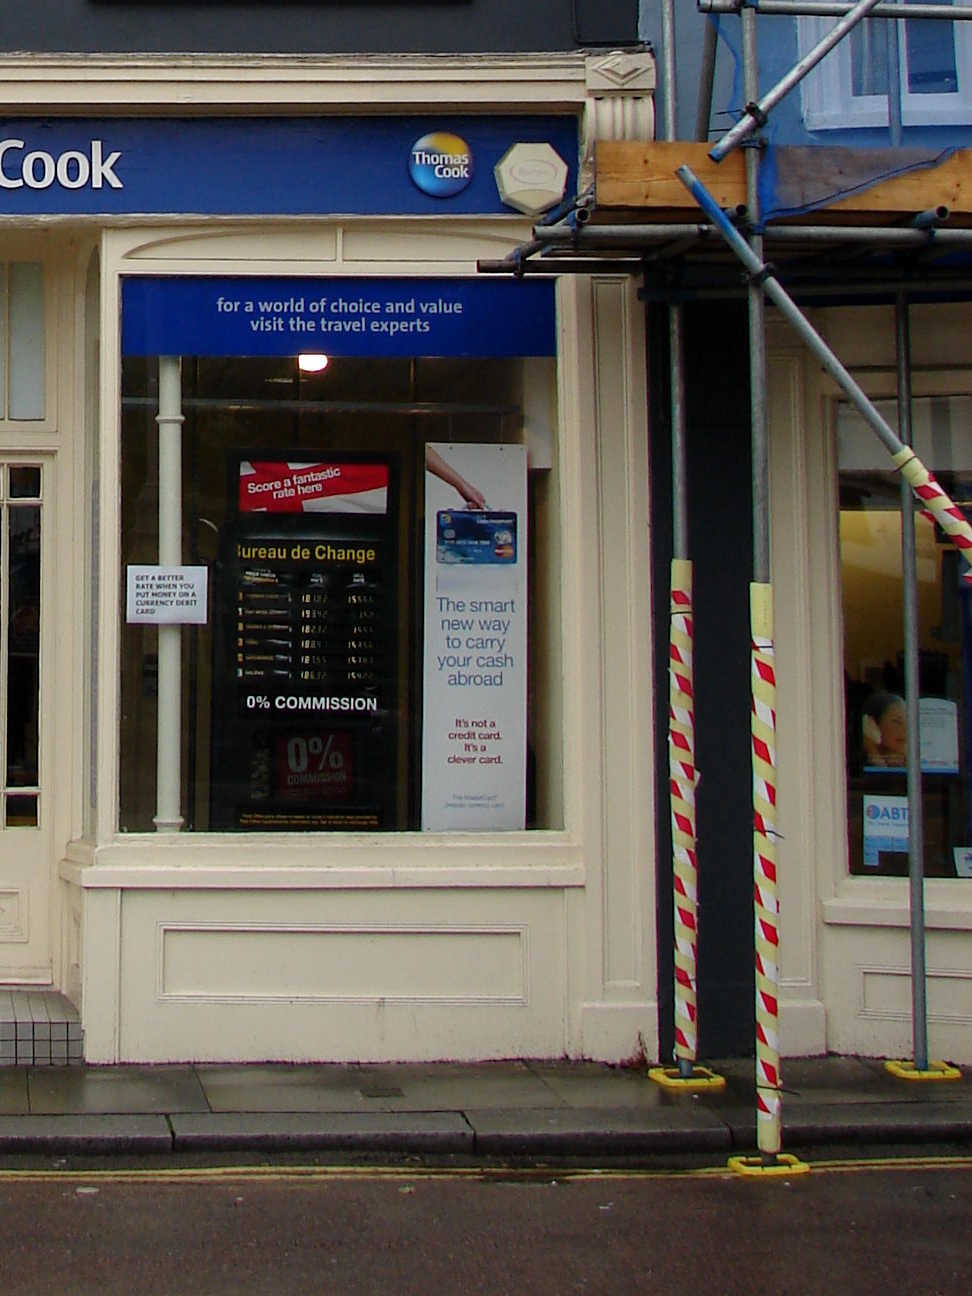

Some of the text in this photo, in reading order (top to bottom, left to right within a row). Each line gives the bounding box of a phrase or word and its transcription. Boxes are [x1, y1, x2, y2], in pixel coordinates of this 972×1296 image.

[413, 151, 469, 165] Thomas
[434, 165, 469, 179] Cook
[216, 297, 463, 314] for a world of choice and value
[250, 317, 430, 336] visit the travel experts
[247, 466, 341, 494] Score a fantastic
[273, 483, 322, 500] rate here
[291, 545, 310, 559] de
[315, 545, 376, 564] Change
[436, 596, 516, 614] The smart
[441, 618, 511, 635] new way
[446, 636, 506, 653] to carry
[437, 654, 514, 671] your cash
[447, 671, 504, 687] abroad
[246, 695, 378, 711] 0% COMMISSION
[455, 718, 469, 728] It's
[471, 719, 487, 728] not
[448, 731, 477, 740] credit
[287, 735, 345, 773] 0%
[464, 743, 478, 752] It's
[447, 755, 477, 764] clever
[287, 771, 347, 785] COMMISSION
[881, 806, 908, 820] ABT
